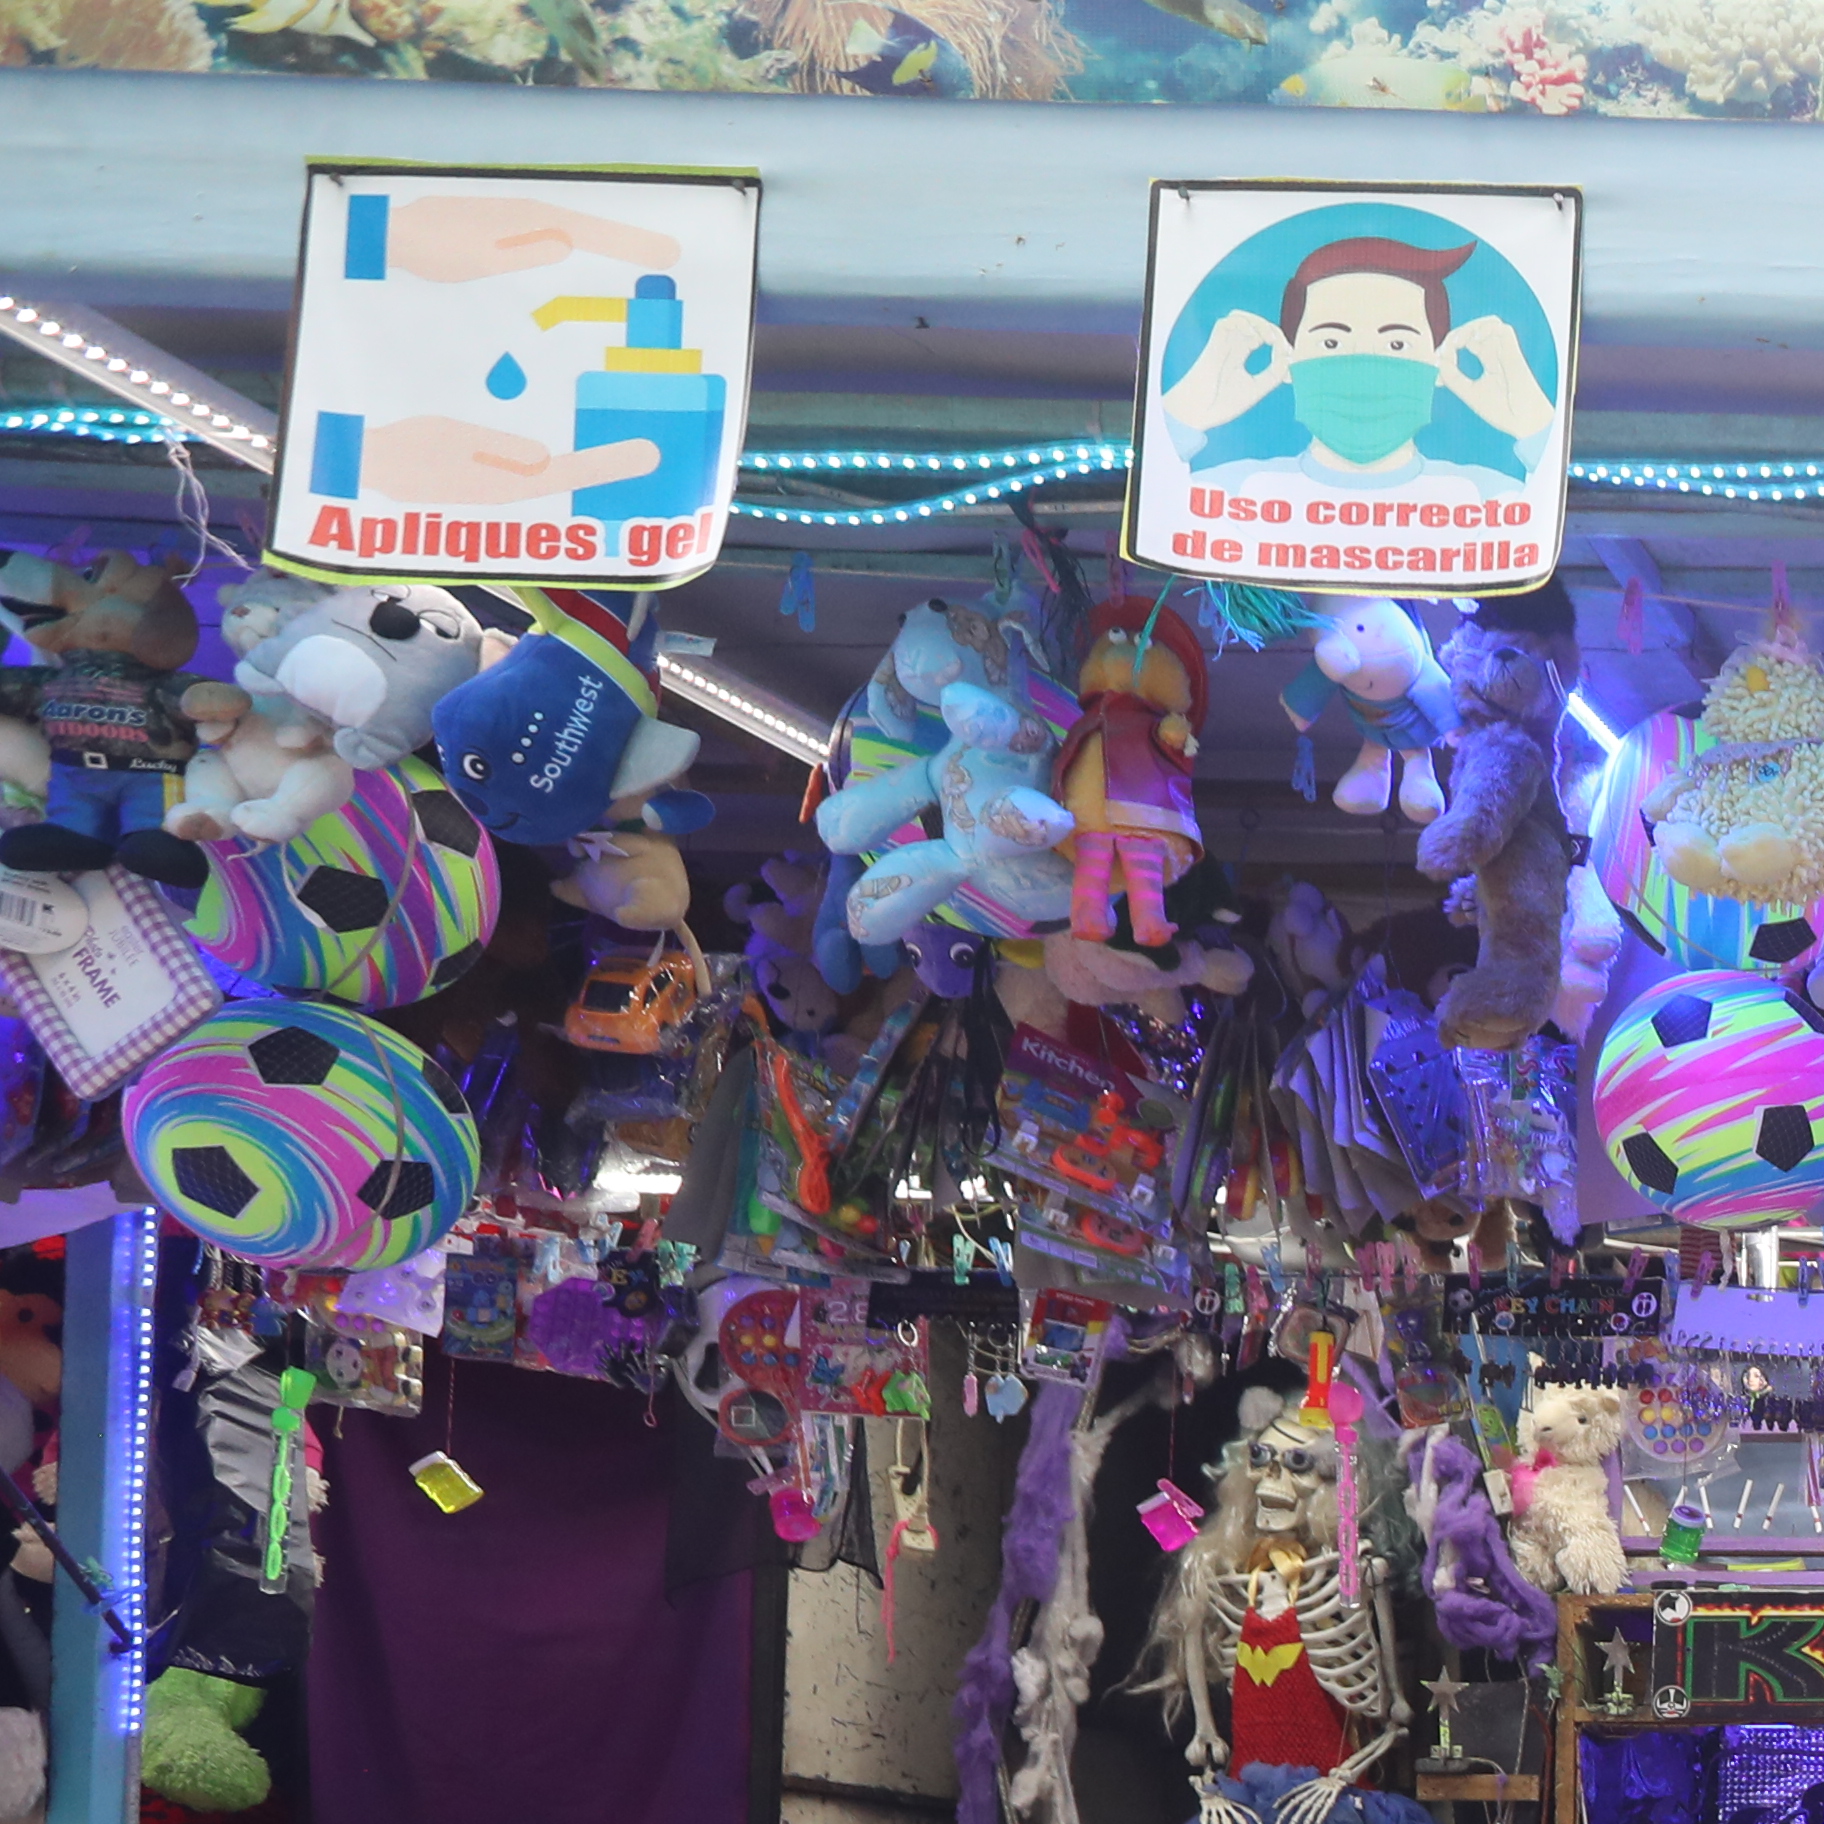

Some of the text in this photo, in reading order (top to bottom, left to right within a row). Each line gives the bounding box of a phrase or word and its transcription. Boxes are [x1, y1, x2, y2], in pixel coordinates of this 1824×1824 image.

[1190, 487, 1531, 529] Uso correcto
[308, 504, 715, 567] Apliques gel
[1172, 530, 1539, 572] de mascarilla
[530, 674, 603, 793] Southwest
[129, 756, 178, 774] Lucky
[72, 946, 123, 1010] FRAME
[1020, 1035, 1117, 1091] Kitchen
[1543, 1296, 1615, 1315] CHAIN
